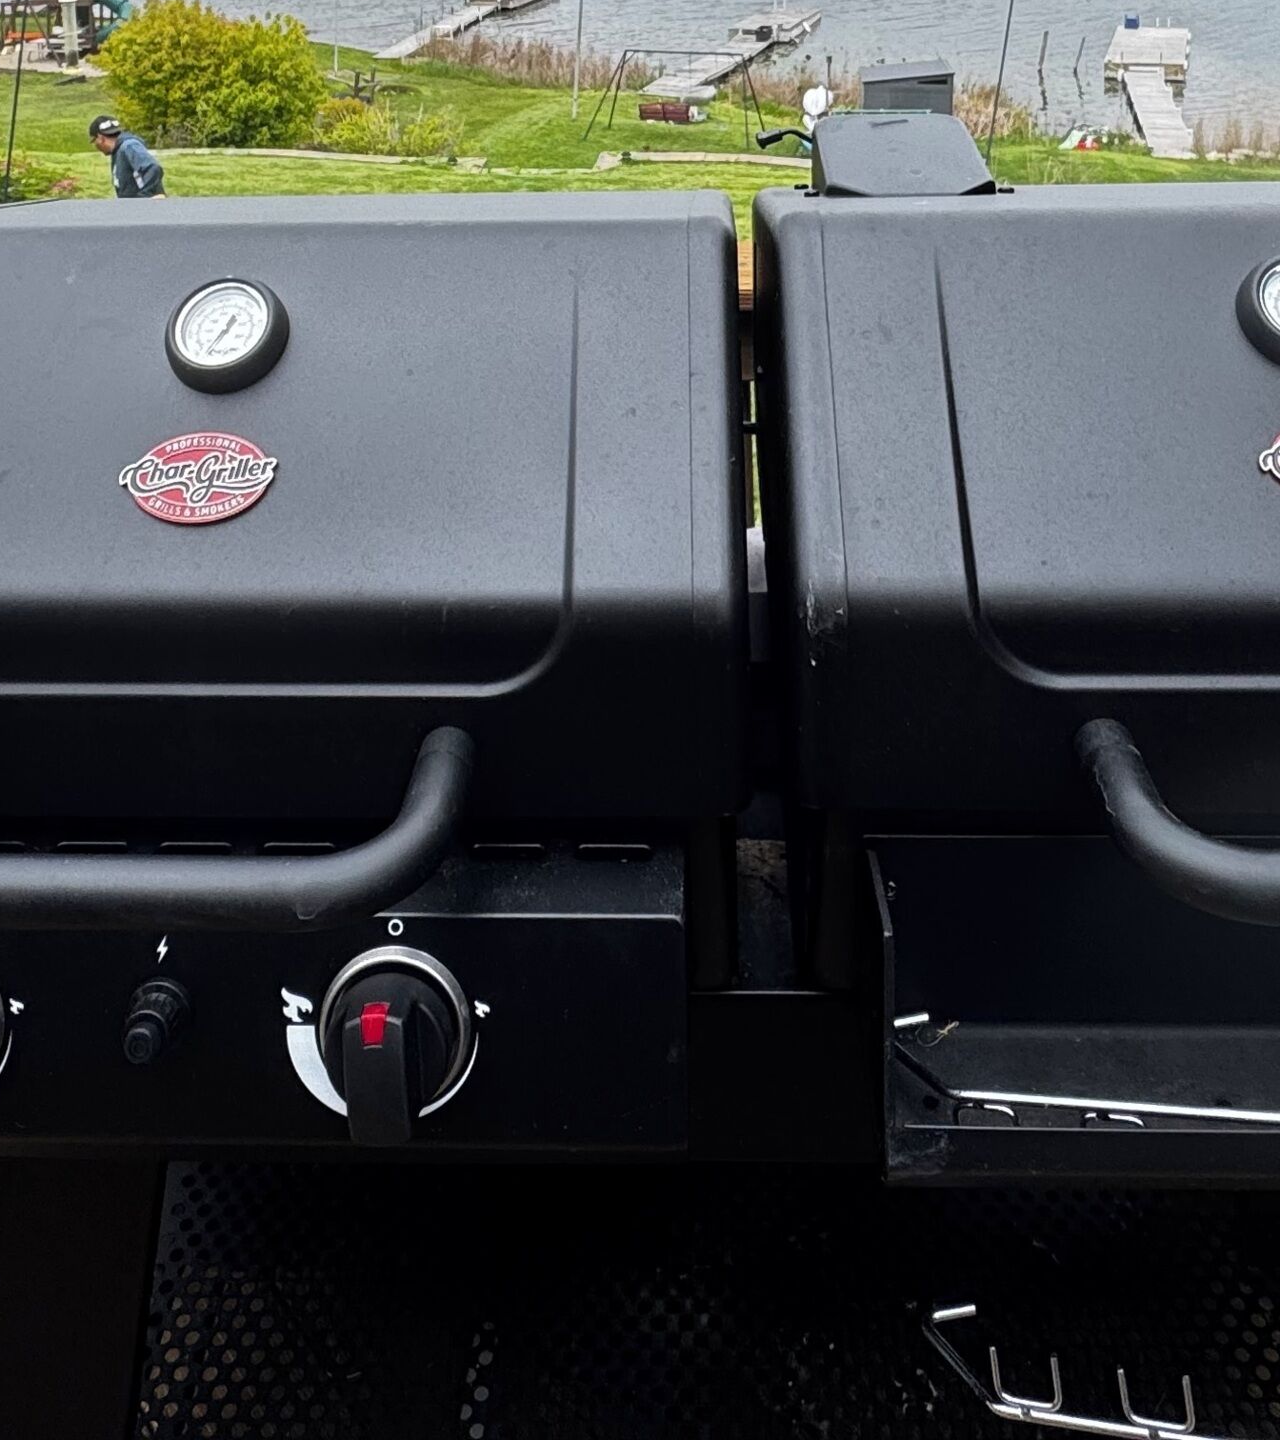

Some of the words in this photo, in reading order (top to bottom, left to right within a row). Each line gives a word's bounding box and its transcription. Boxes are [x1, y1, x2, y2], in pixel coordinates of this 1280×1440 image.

[166, 436, 241, 453] PROFESSIONAL
[120, 453, 277, 505] Char-Griller
[148, 496, 181, 516] GRILLS
[195, 494, 245, 516] SMOKERS
